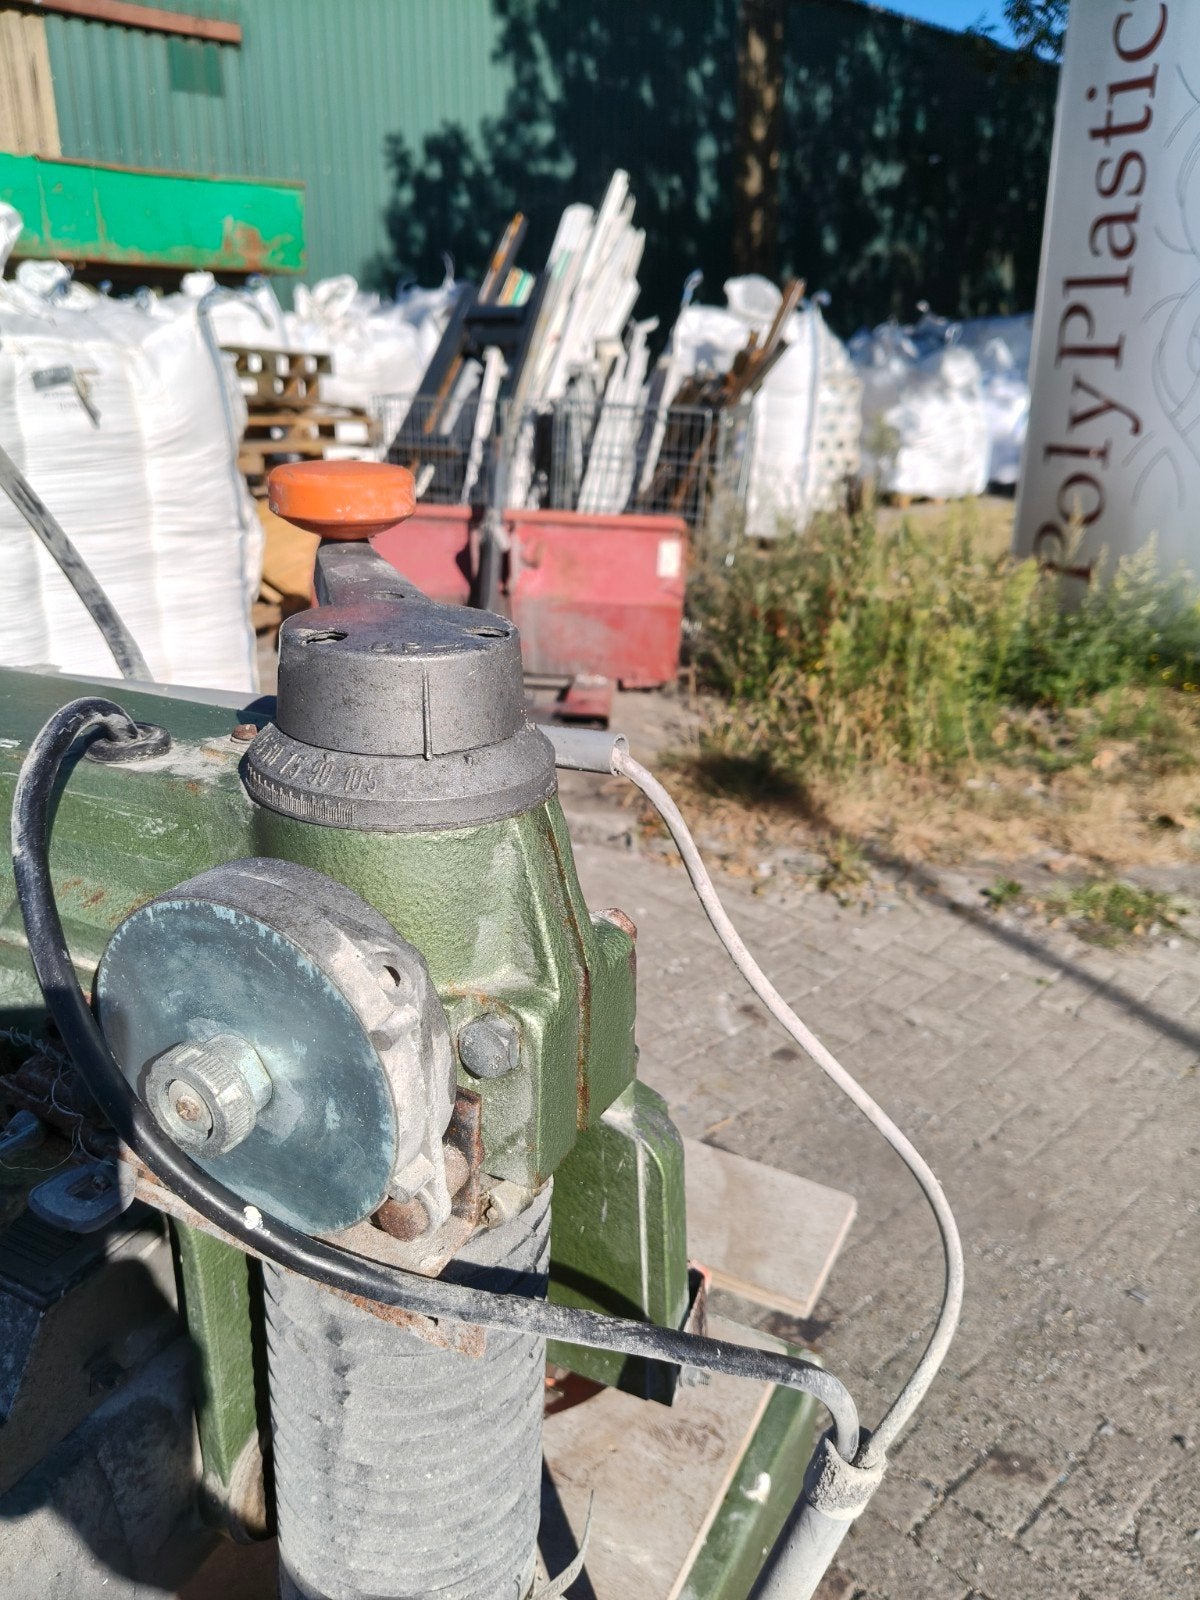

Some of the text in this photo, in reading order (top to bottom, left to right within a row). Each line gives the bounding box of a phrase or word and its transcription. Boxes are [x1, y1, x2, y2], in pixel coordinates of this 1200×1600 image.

[1033, 0, 1168, 582] PolyPlastic
[306, 760, 336, 786] 90
[343, 766, 379, 793] 105
